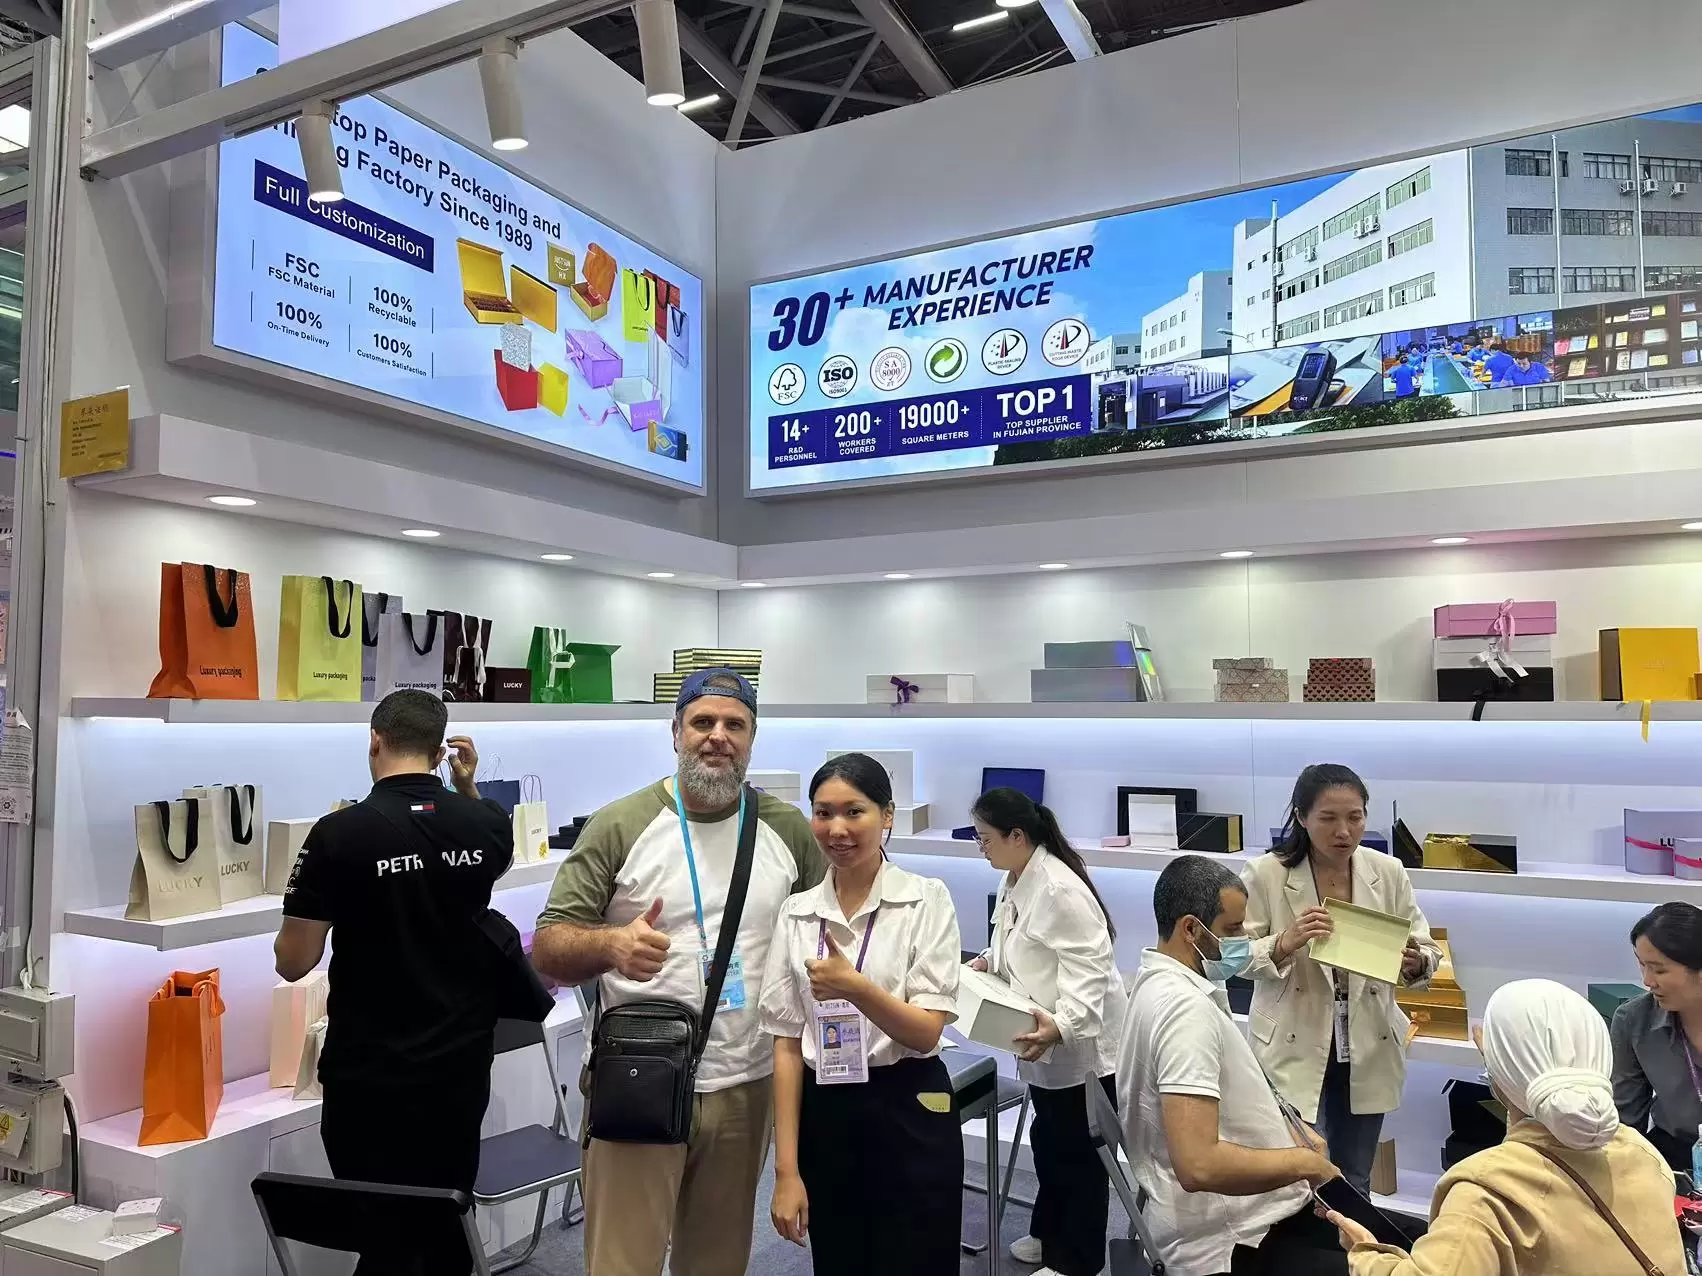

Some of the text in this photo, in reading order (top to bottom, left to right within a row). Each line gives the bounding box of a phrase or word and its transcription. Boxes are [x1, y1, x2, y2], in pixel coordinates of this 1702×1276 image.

[375, 126, 432, 172] Paper
[438, 160, 528, 226] Packaging
[533, 214, 561, 240] and
[358, 151, 434, 206] Factory
[440, 192, 490, 231] Since
[496, 220, 533, 251] 1989
[266, 176, 424, 259] Full Customization
[286, 252, 320, 278] FSC
[268, 266, 335, 298] FSC Material
[374, 286, 413, 313] 100%
[767, 245, 1095, 351] 30+ MANUFACTURER
[888, 281, 1054, 331] EXPERIENCE
[276, 302, 322, 329] 100%
[368, 302, 417, 328] Recyclable
[268, 321, 330, 348] On-Time Delivery
[374, 334, 413, 358] 100%
[357, 349, 427, 377] Customers Satisfaction
[823, 366, 854, 382] ISO
[778, 391, 798, 401] FSC
[996, 384, 1073, 418] TOP 1
[899, 400, 970, 430] 19000+
[1006, 416, 1068, 430] TOP SUPPLIER
[781, 418, 810, 442] 14+
[902, 430, 970, 445] SQUARE METERS
[993, 422, 1082, 439] IN FUJIAN PROVINCE
[788, 446, 804, 454] R&D
[838, 438, 877, 448] WORKERS
[840, 446, 876, 456] COVERED
[774, 452, 818, 463] PERSONNEL
[200, 665, 242, 678] Luxury packaging
[313, 672, 348, 680] Luxury packaging
[395, 682, 437, 690] Luxury packaging
[221, 860, 250, 876] LUCKY
[376, 849, 483, 877] PETRNAS
